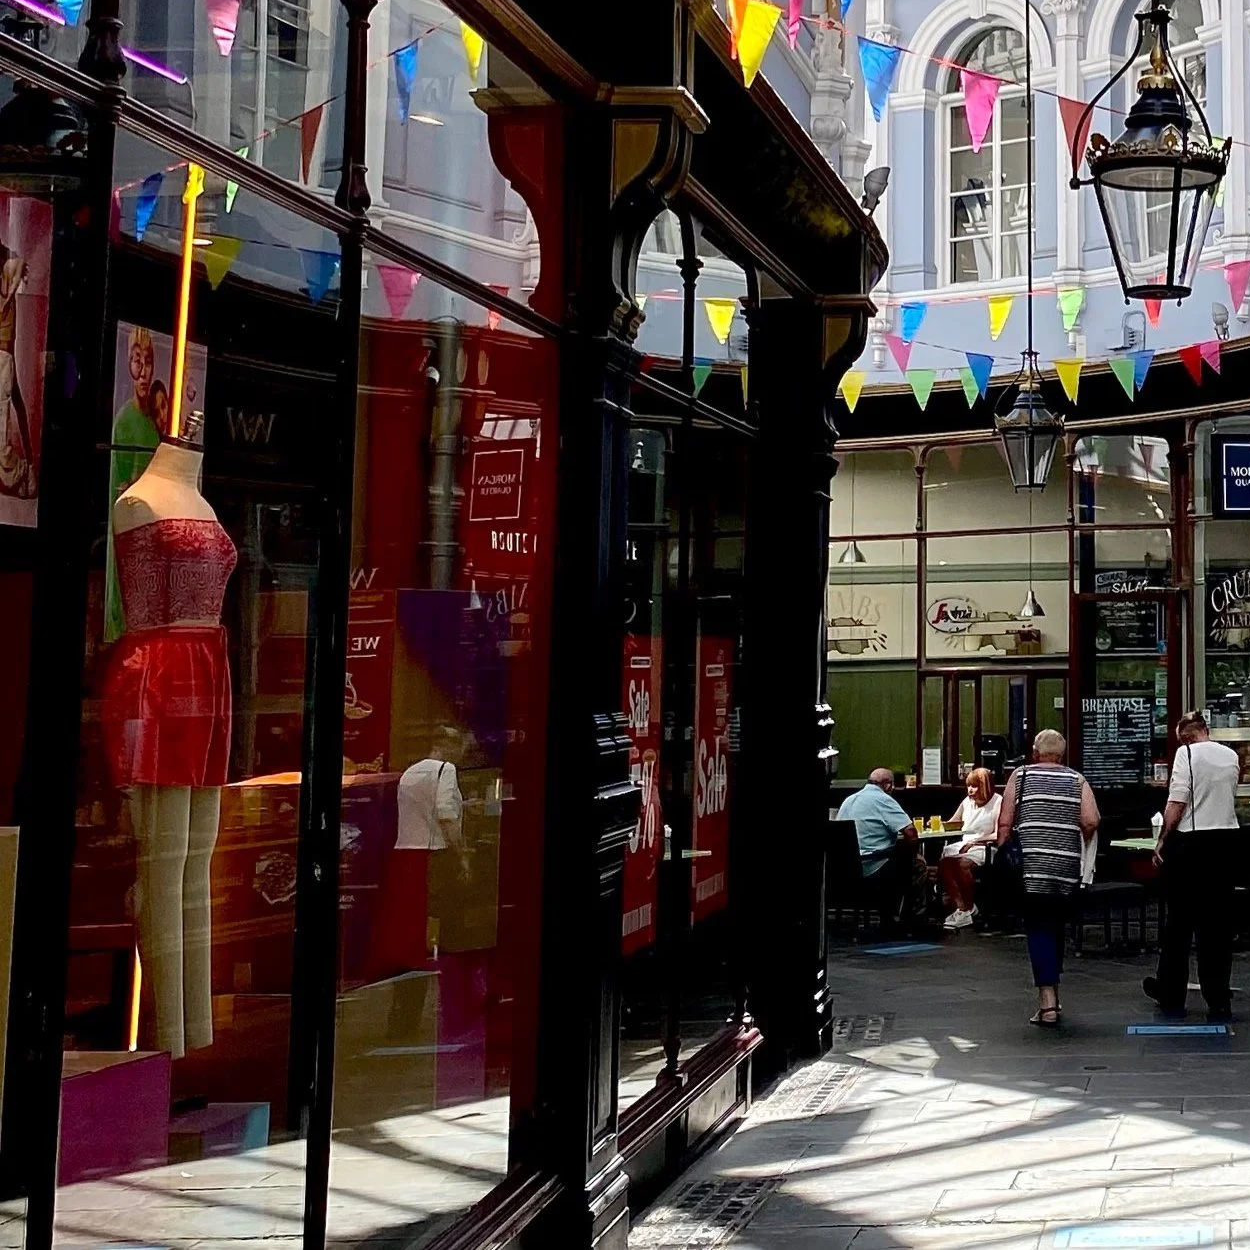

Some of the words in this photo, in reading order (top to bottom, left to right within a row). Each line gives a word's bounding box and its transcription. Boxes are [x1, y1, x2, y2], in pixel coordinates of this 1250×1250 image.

[491, 530, 528, 554] ROUTE
[628, 678, 651, 730] Sale
[1082, 698, 1147, 713] BREAKFAST
[697, 735, 728, 819] Sale
